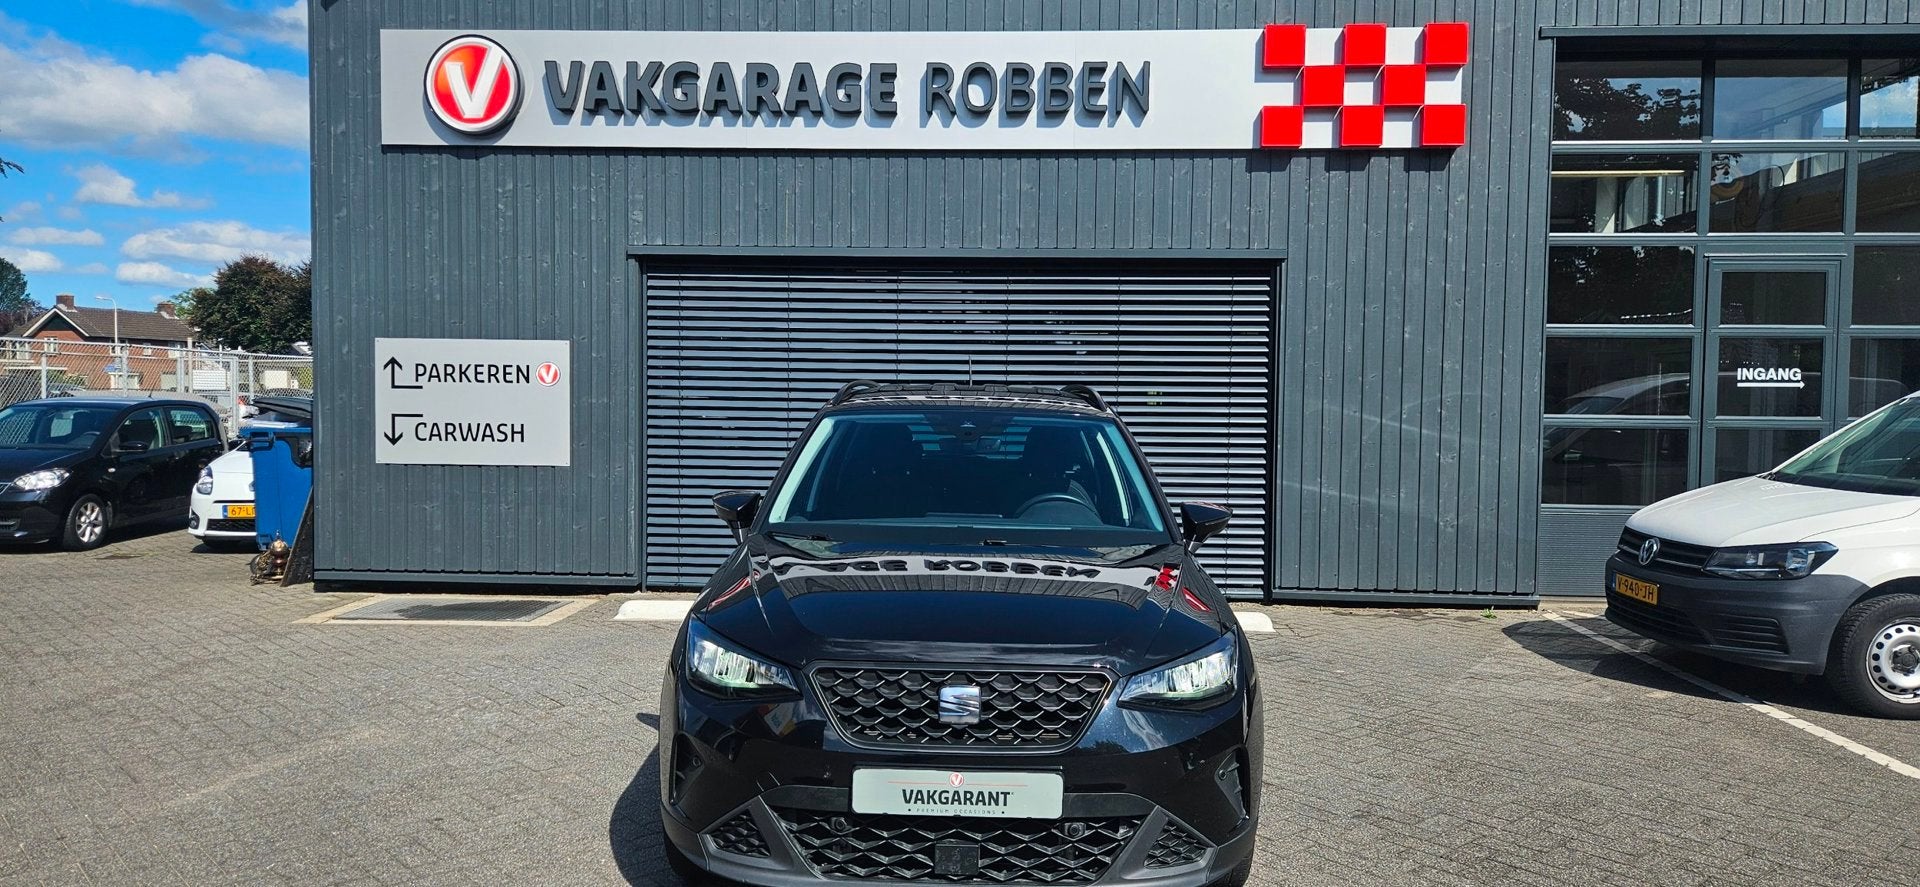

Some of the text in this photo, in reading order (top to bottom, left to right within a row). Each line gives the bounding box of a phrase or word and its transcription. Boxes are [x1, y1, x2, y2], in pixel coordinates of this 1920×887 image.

[544, 60, 898, 115] VAKGARAGE
[925, 60, 1150, 116] ROBBEN
[414, 363, 530, 384] PARKEREN
[1737, 367, 1802, 381] INGANG
[414, 422, 525, 443] CARWASH
[1617, 575, 1655, 603] V-940-JH
[902, 789, 1011, 807] VAKGARANT
